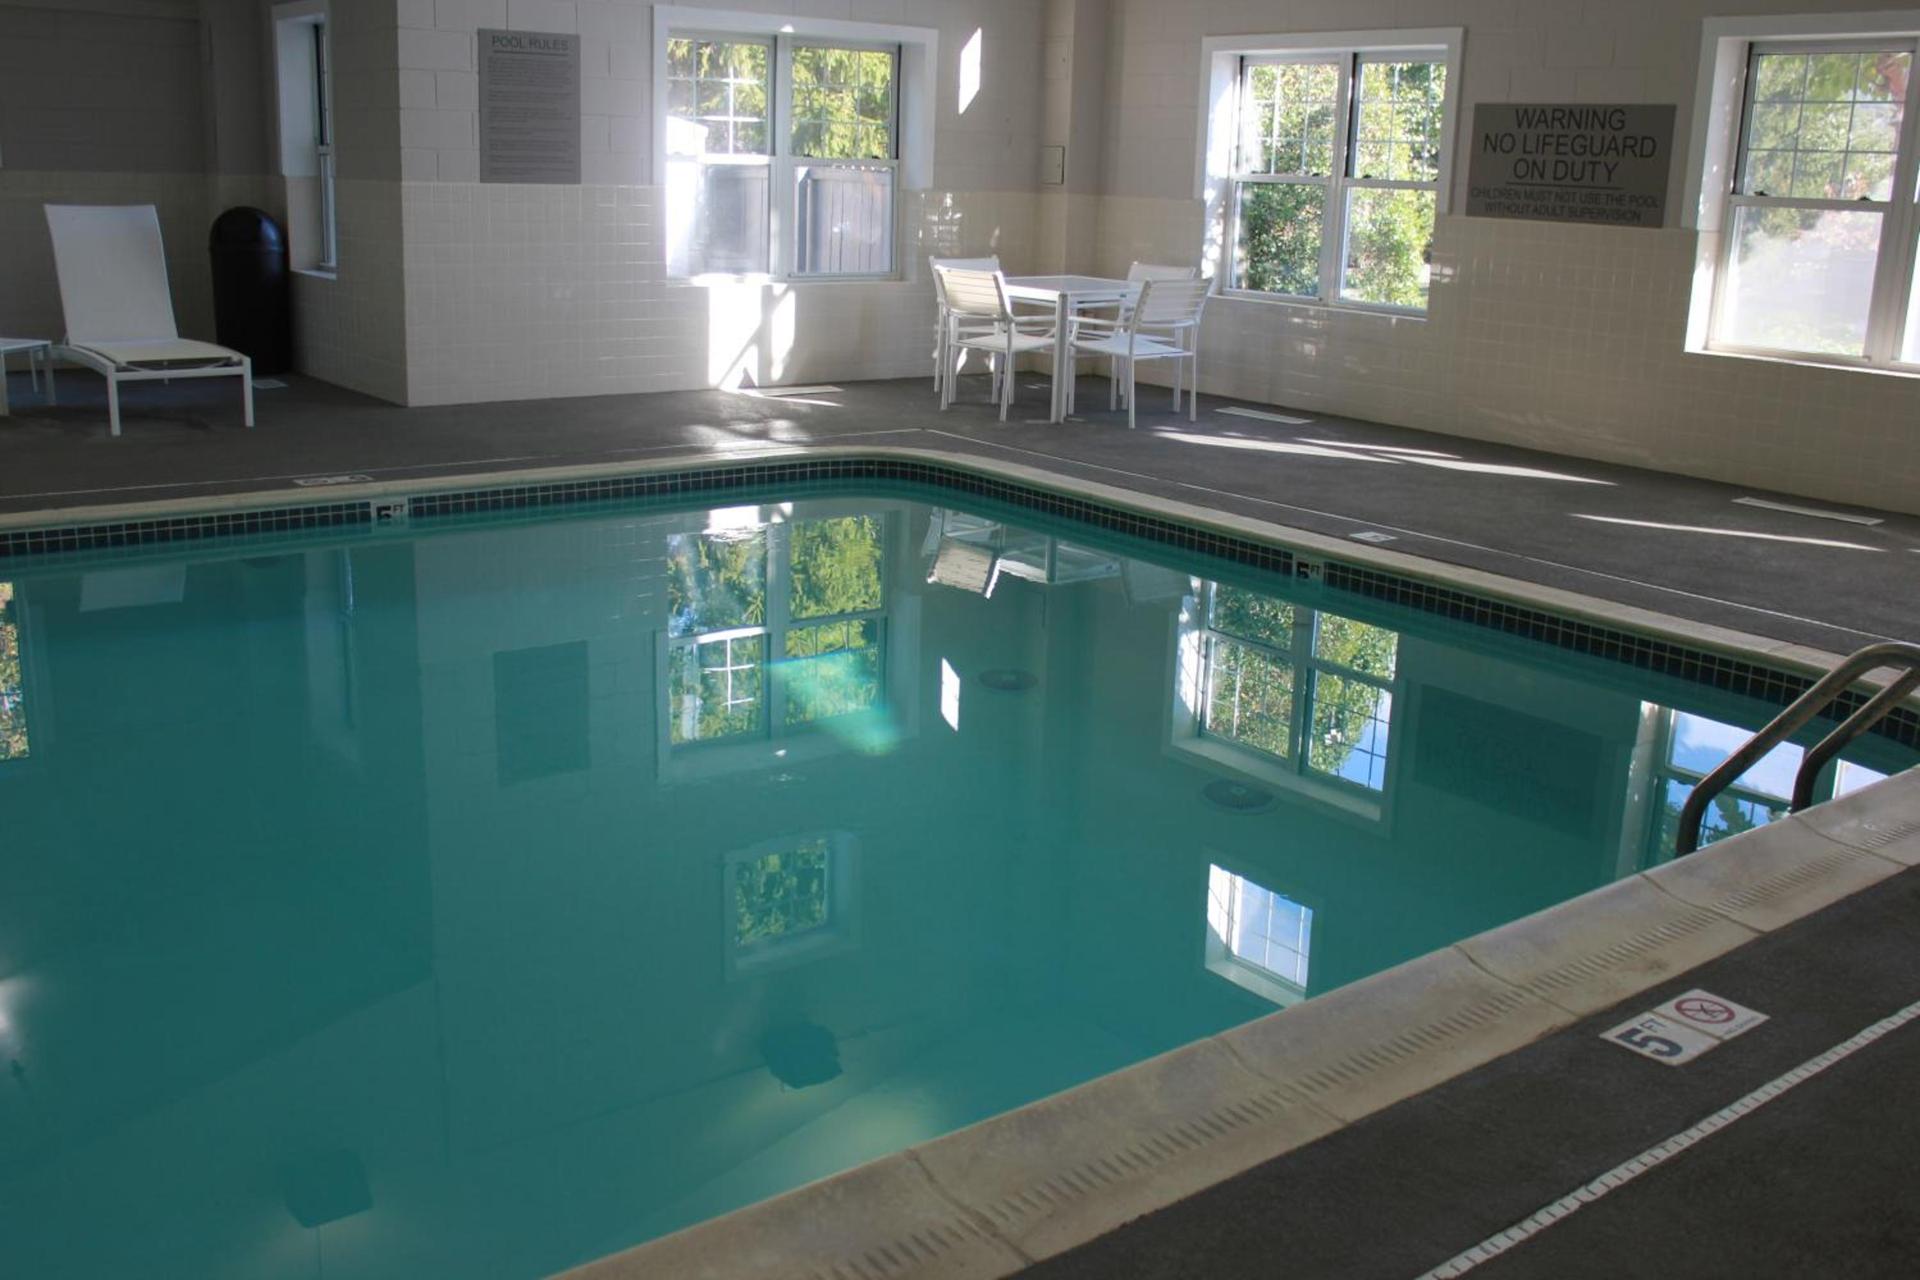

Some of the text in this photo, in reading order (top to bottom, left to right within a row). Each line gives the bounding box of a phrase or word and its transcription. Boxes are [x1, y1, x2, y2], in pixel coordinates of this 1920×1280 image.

[492, 34, 569, 51] POOL RULES
[1515, 107, 1625, 131] WARNING
[1483, 132, 1657, 158] NO LIFEGUARD
[1513, 158, 1620, 183] ON DUTY
[1604, 193, 1627, 207] THE
[1629, 194, 1659, 208] POOL
[376, 505, 392, 519] 5
[1296, 561, 1309, 578] 5
[1615, 1027, 1683, 1058] 5
